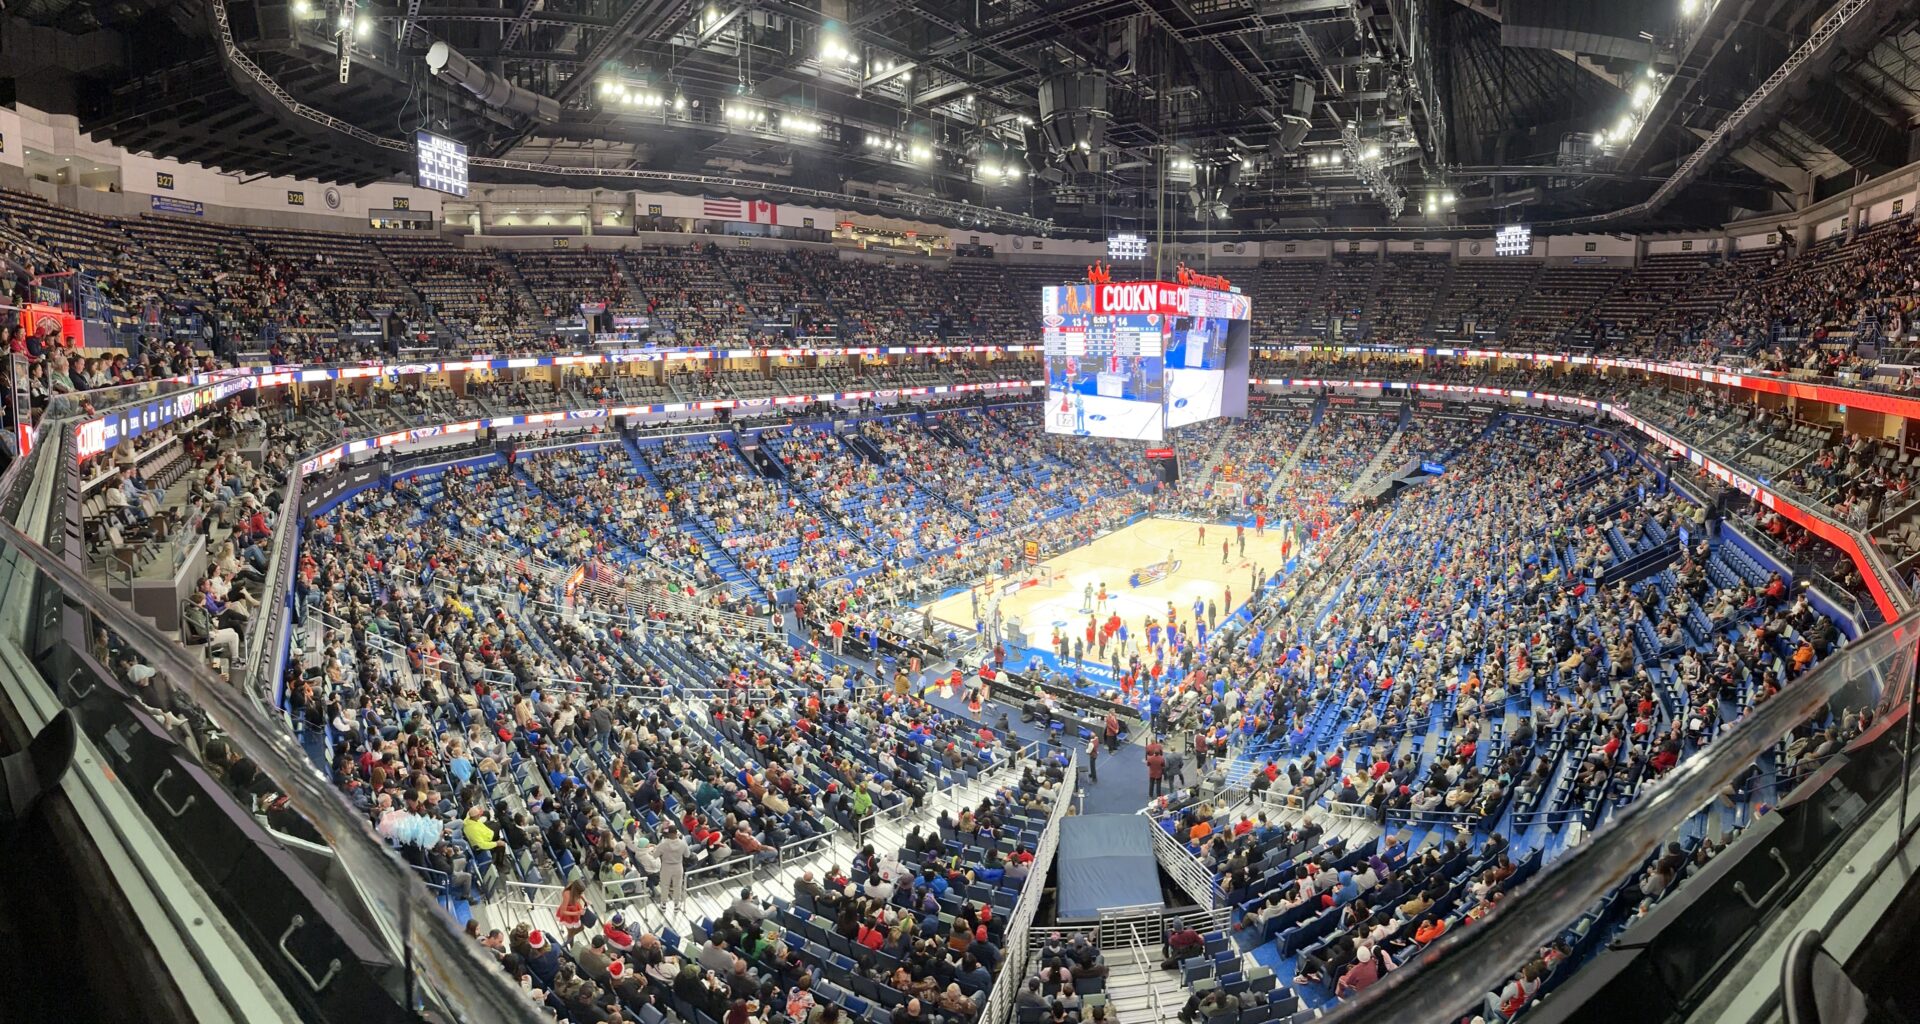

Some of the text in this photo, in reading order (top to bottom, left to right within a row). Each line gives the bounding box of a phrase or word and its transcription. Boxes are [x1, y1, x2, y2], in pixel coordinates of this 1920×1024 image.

[157, 175, 173, 187] 327
[288, 193, 304, 203] 328
[393, 199, 409, 208] 329
[650, 206, 661, 214] 331
[553, 239, 569, 247] 330
[1102, 284, 1158, 312] COOKN
[1072, 318, 1082, 326] 13
[1117, 317, 1128, 327] 14
[143, 410, 148, 427] 6
